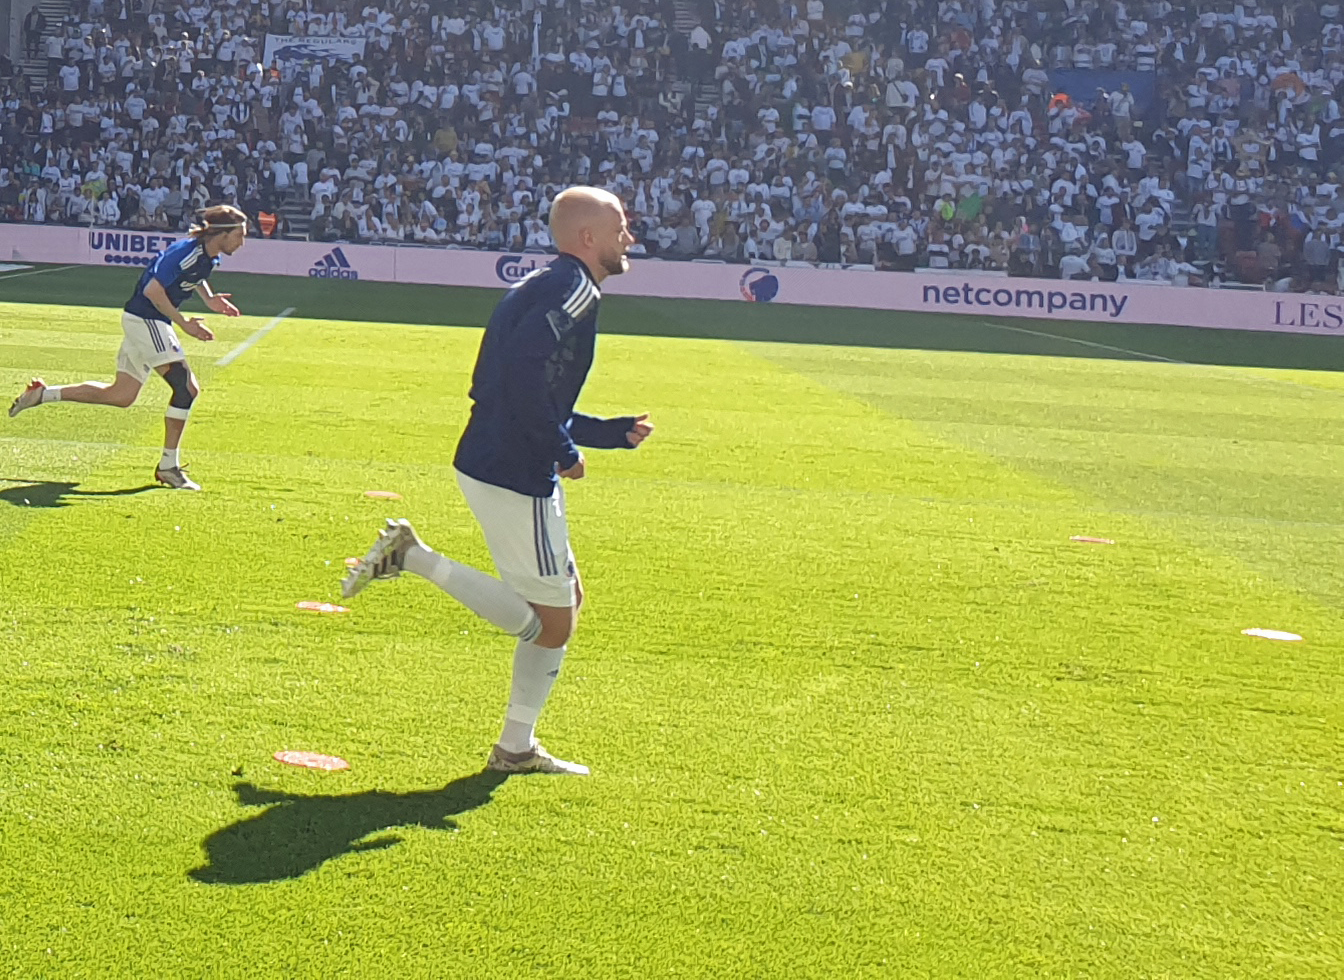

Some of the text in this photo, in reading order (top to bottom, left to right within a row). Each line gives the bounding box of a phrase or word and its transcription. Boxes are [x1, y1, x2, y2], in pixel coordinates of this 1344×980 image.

[91, 231, 177, 254] UNIBET
[308, 266, 359, 280] adidas
[922, 282, 1128, 317] netcompany
[1273, 301, 1343, 329] LES
